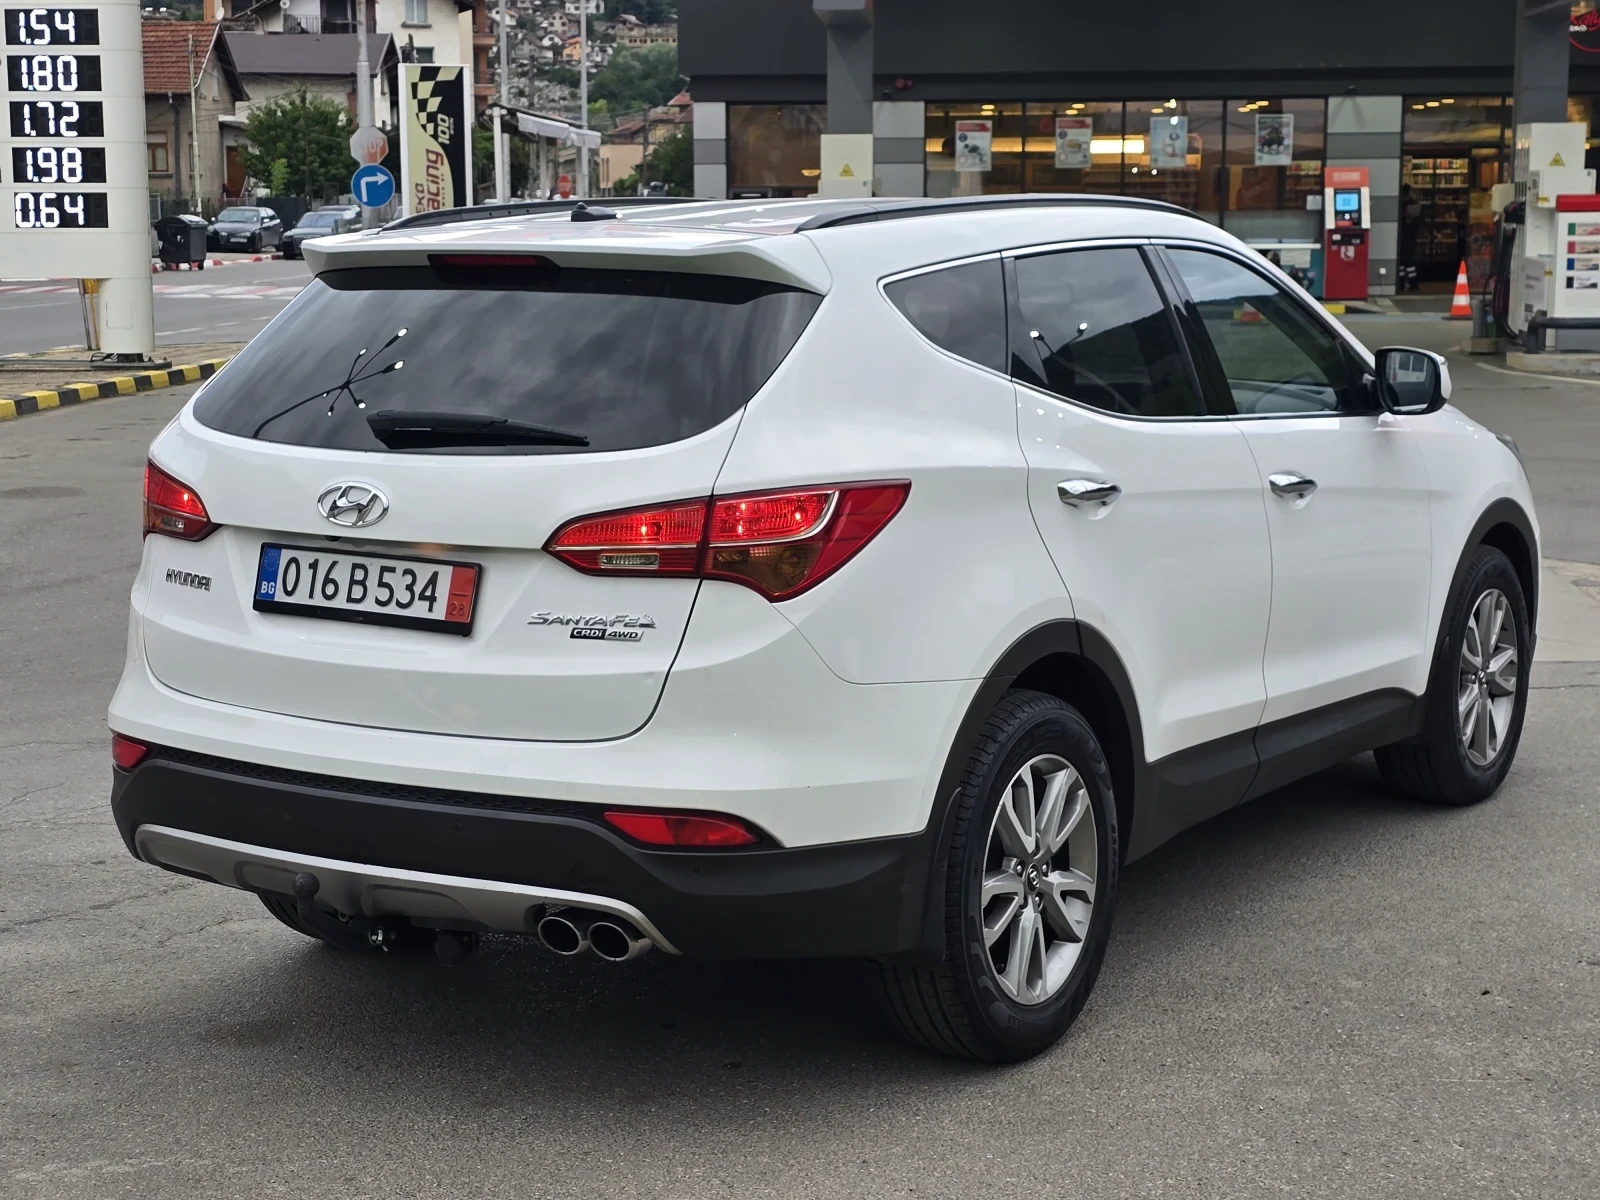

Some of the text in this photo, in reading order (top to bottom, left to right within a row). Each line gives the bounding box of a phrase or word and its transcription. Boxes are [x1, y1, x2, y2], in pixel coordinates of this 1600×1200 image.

[18, 8, 76, 45] 1.54
[21, 55, 78, 91] 1.80
[24, 101, 80, 137] 1.72
[437, 113, 450, 145] 100
[26, 147, 83, 183] 1.98
[425, 148, 445, 212] acing
[15, 192, 85, 228] 0.64
[165, 568, 213, 592] HYUNDAI
[260, 581, 276, 595] BG
[449, 602, 466, 617] 28
[573, 628, 639, 639] CRDi 4WD
